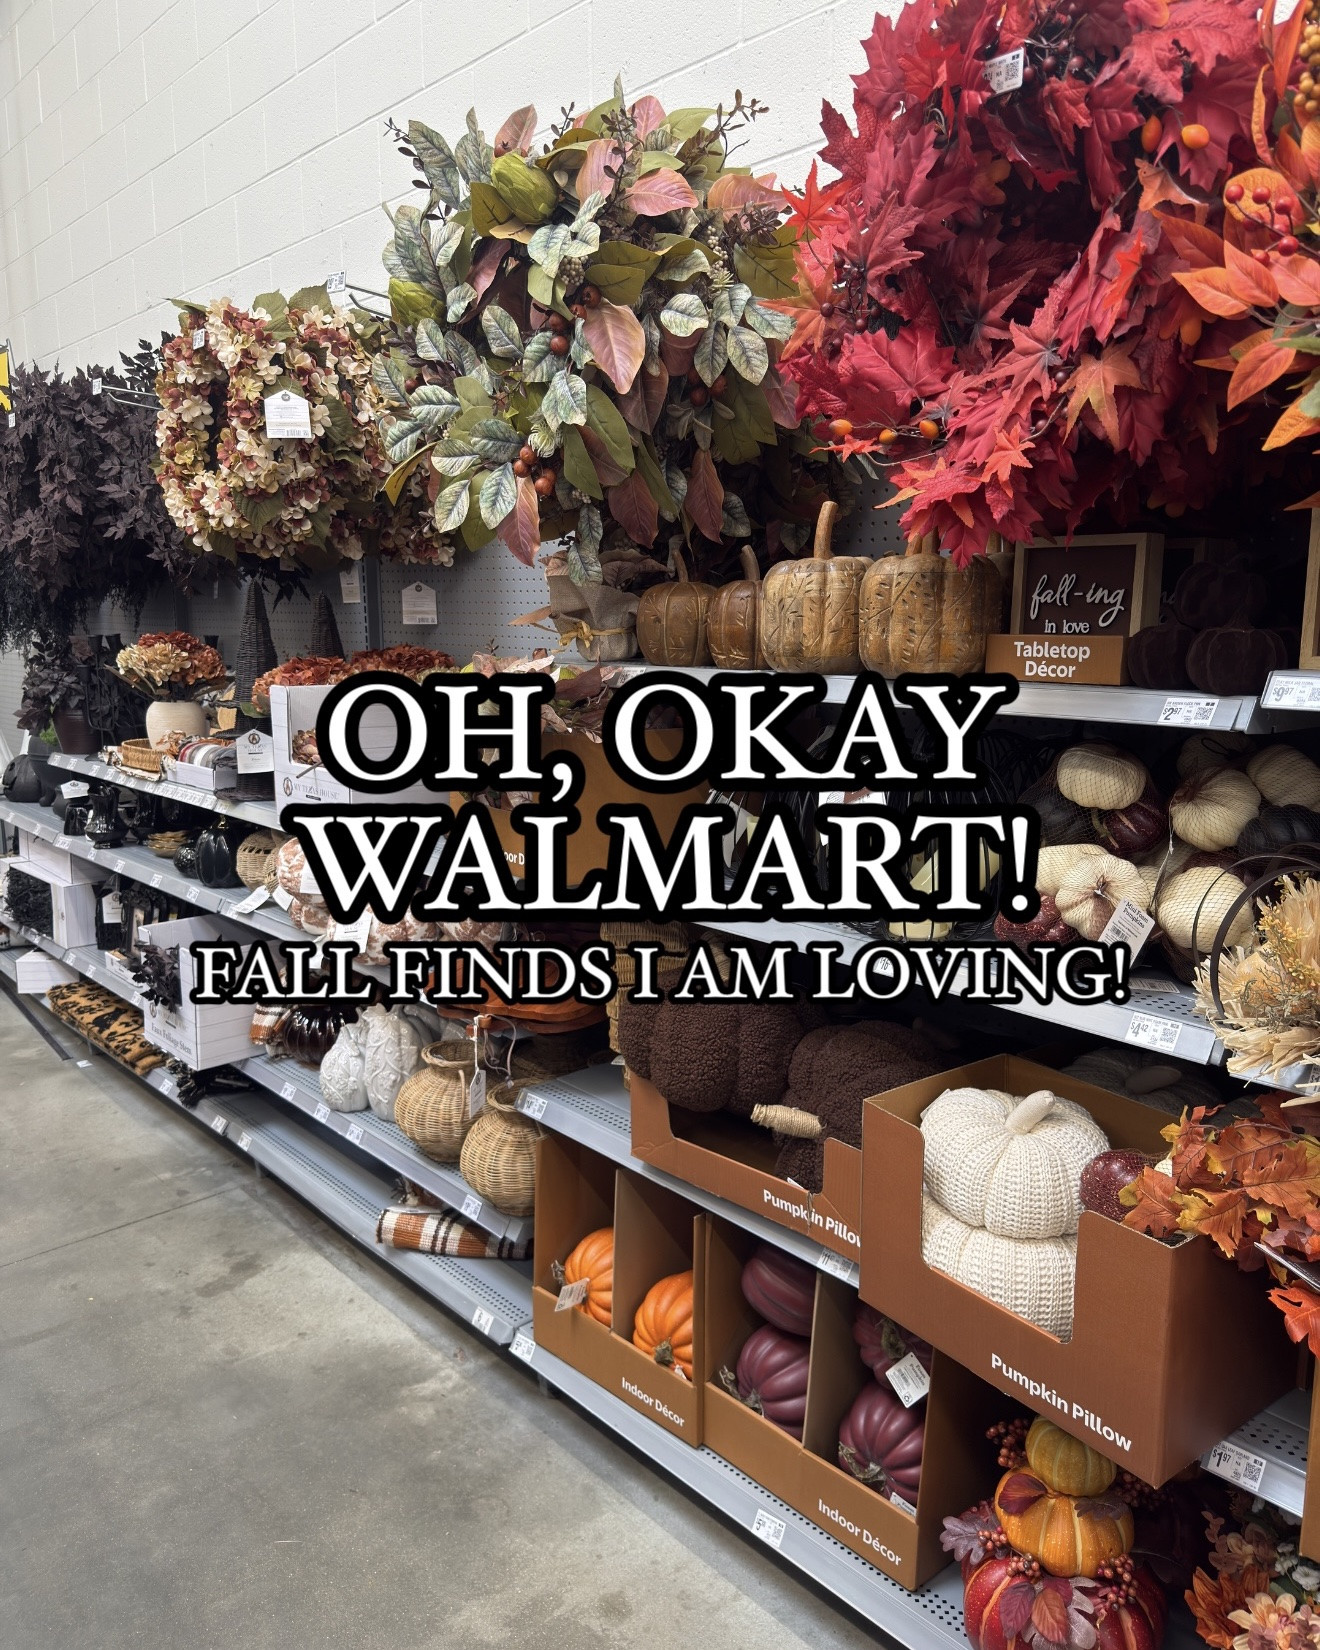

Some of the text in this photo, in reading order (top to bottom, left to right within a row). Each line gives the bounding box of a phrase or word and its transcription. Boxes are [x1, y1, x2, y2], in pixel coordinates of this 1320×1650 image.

[1029, 573, 1125, 627] fall-ing
[1044, 619, 1090, 634] in love
[1013, 641, 1091, 662] Tabletop
[1025, 660, 1076, 678] Décor
[763, 1189, 824, 1228] Pumpkin
[621, 1376, 685, 1427] Indoor Décor
[991, 1352, 1132, 1452] Pumpkin Pillow
[818, 1498, 861, 1537] Indoor
[862, 1528, 902, 1566] Décor
